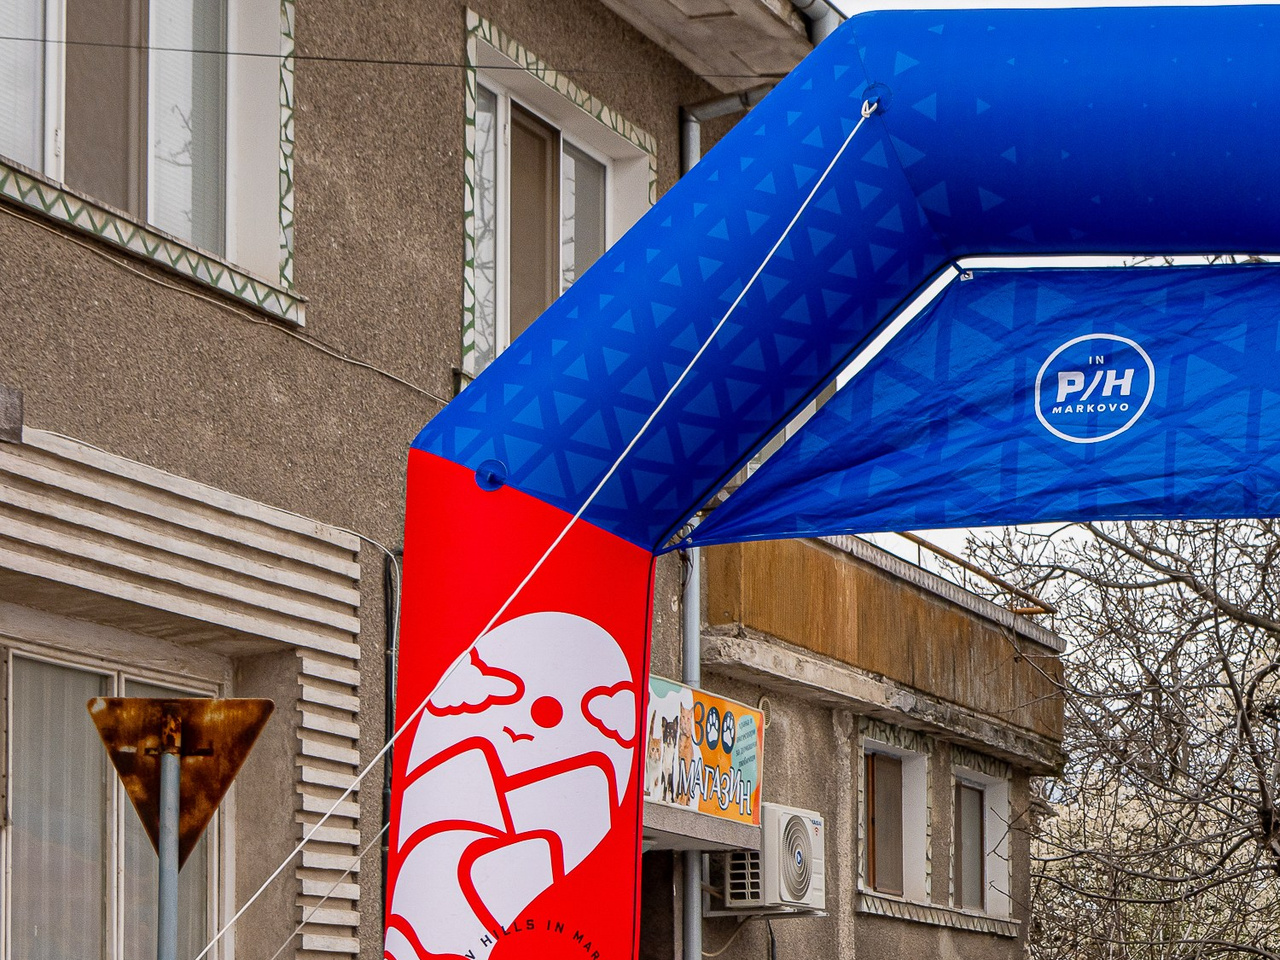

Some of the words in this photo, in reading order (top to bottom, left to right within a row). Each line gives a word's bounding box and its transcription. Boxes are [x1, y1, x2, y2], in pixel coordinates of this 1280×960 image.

[1088, 355, 1105, 365] IN
[1056, 368, 1135, 403] P/H
[1052, 402, 1130, 414] MARKOVO
[678, 757, 752, 816] МАГАЗИН
[480, 919, 535, 948] HILLS
[547, 920, 565, 934] IN
